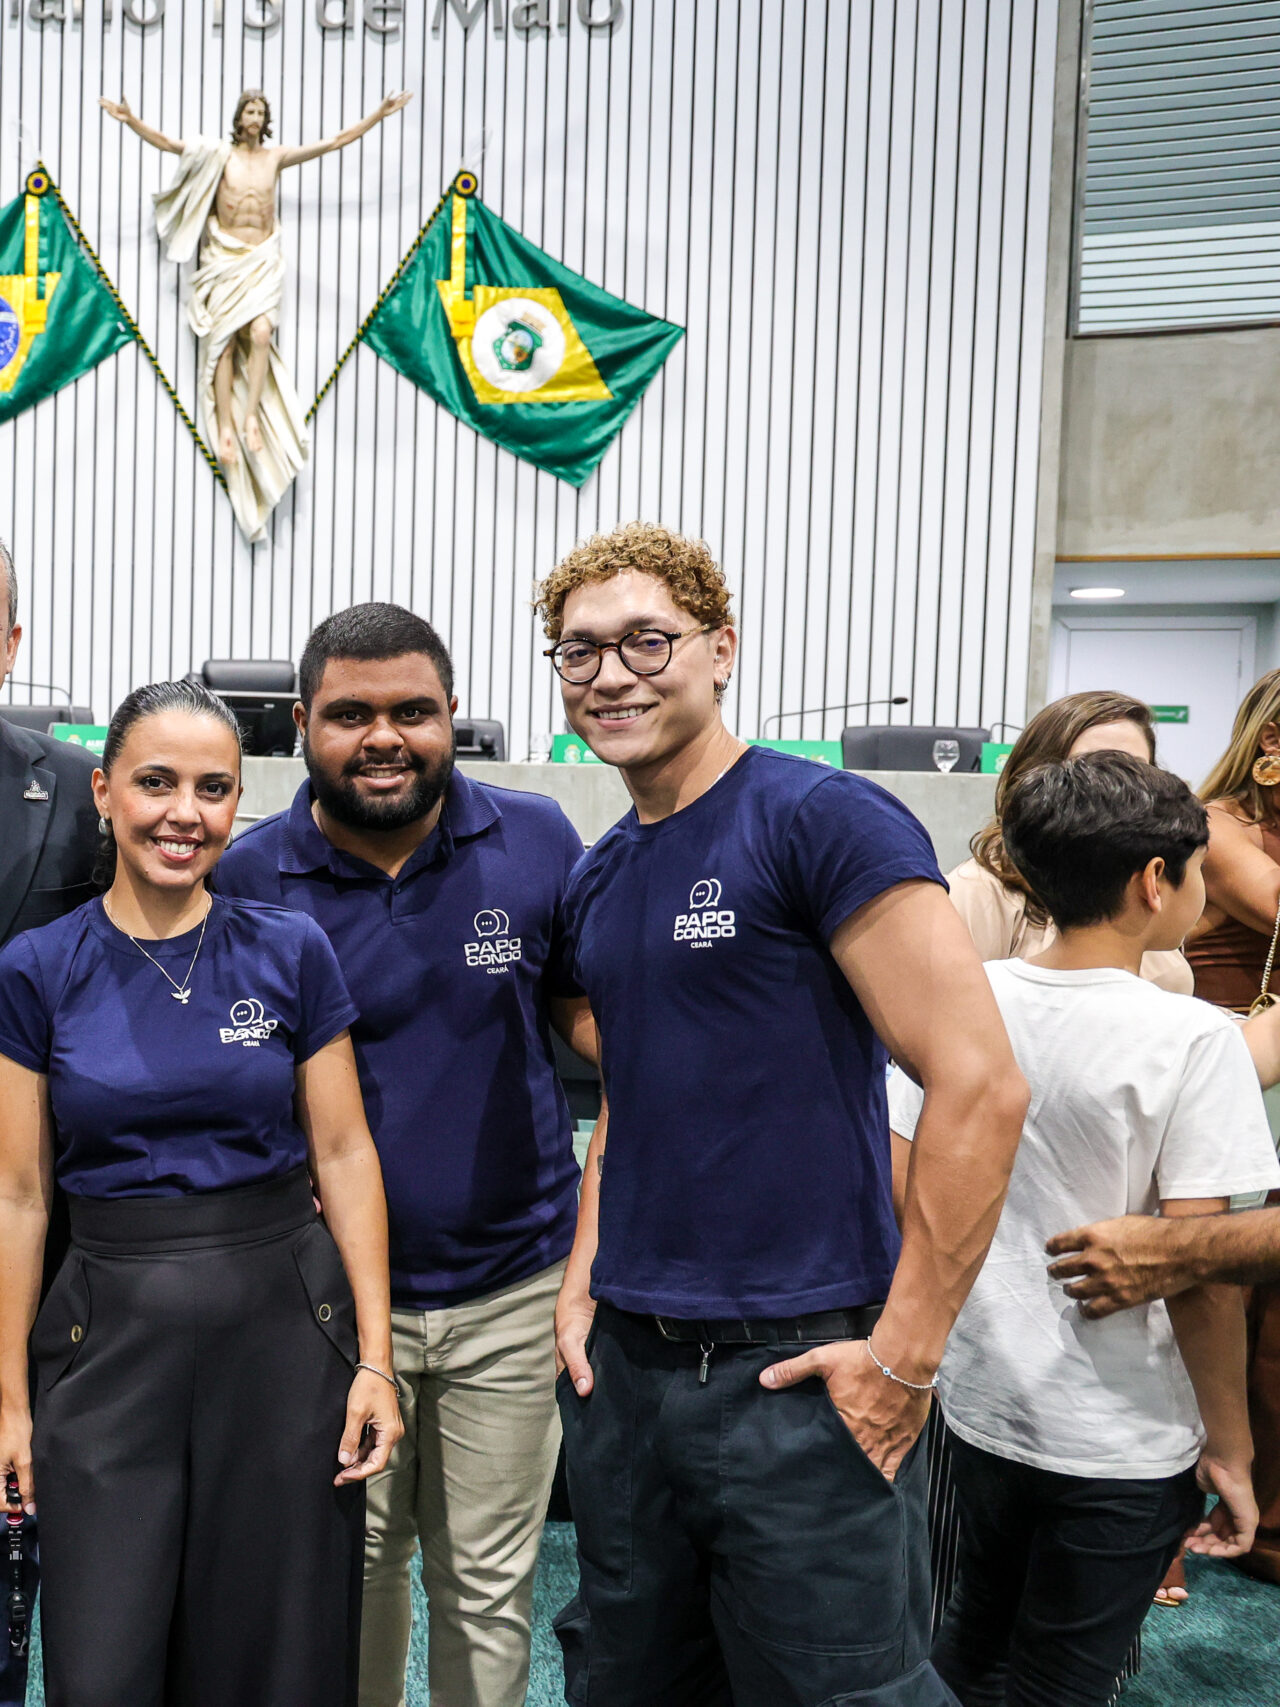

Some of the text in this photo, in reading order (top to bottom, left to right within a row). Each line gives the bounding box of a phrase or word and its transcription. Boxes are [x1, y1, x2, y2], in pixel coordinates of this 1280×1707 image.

[675, 910, 735, 930] PAPO
[673, 925, 736, 941] CONDO
[464, 938, 521, 956] PAPO
[690, 940, 713, 949] CEARÁ
[466, 950, 521, 967] CONDO
[486, 964, 509, 975] CEARÁ
